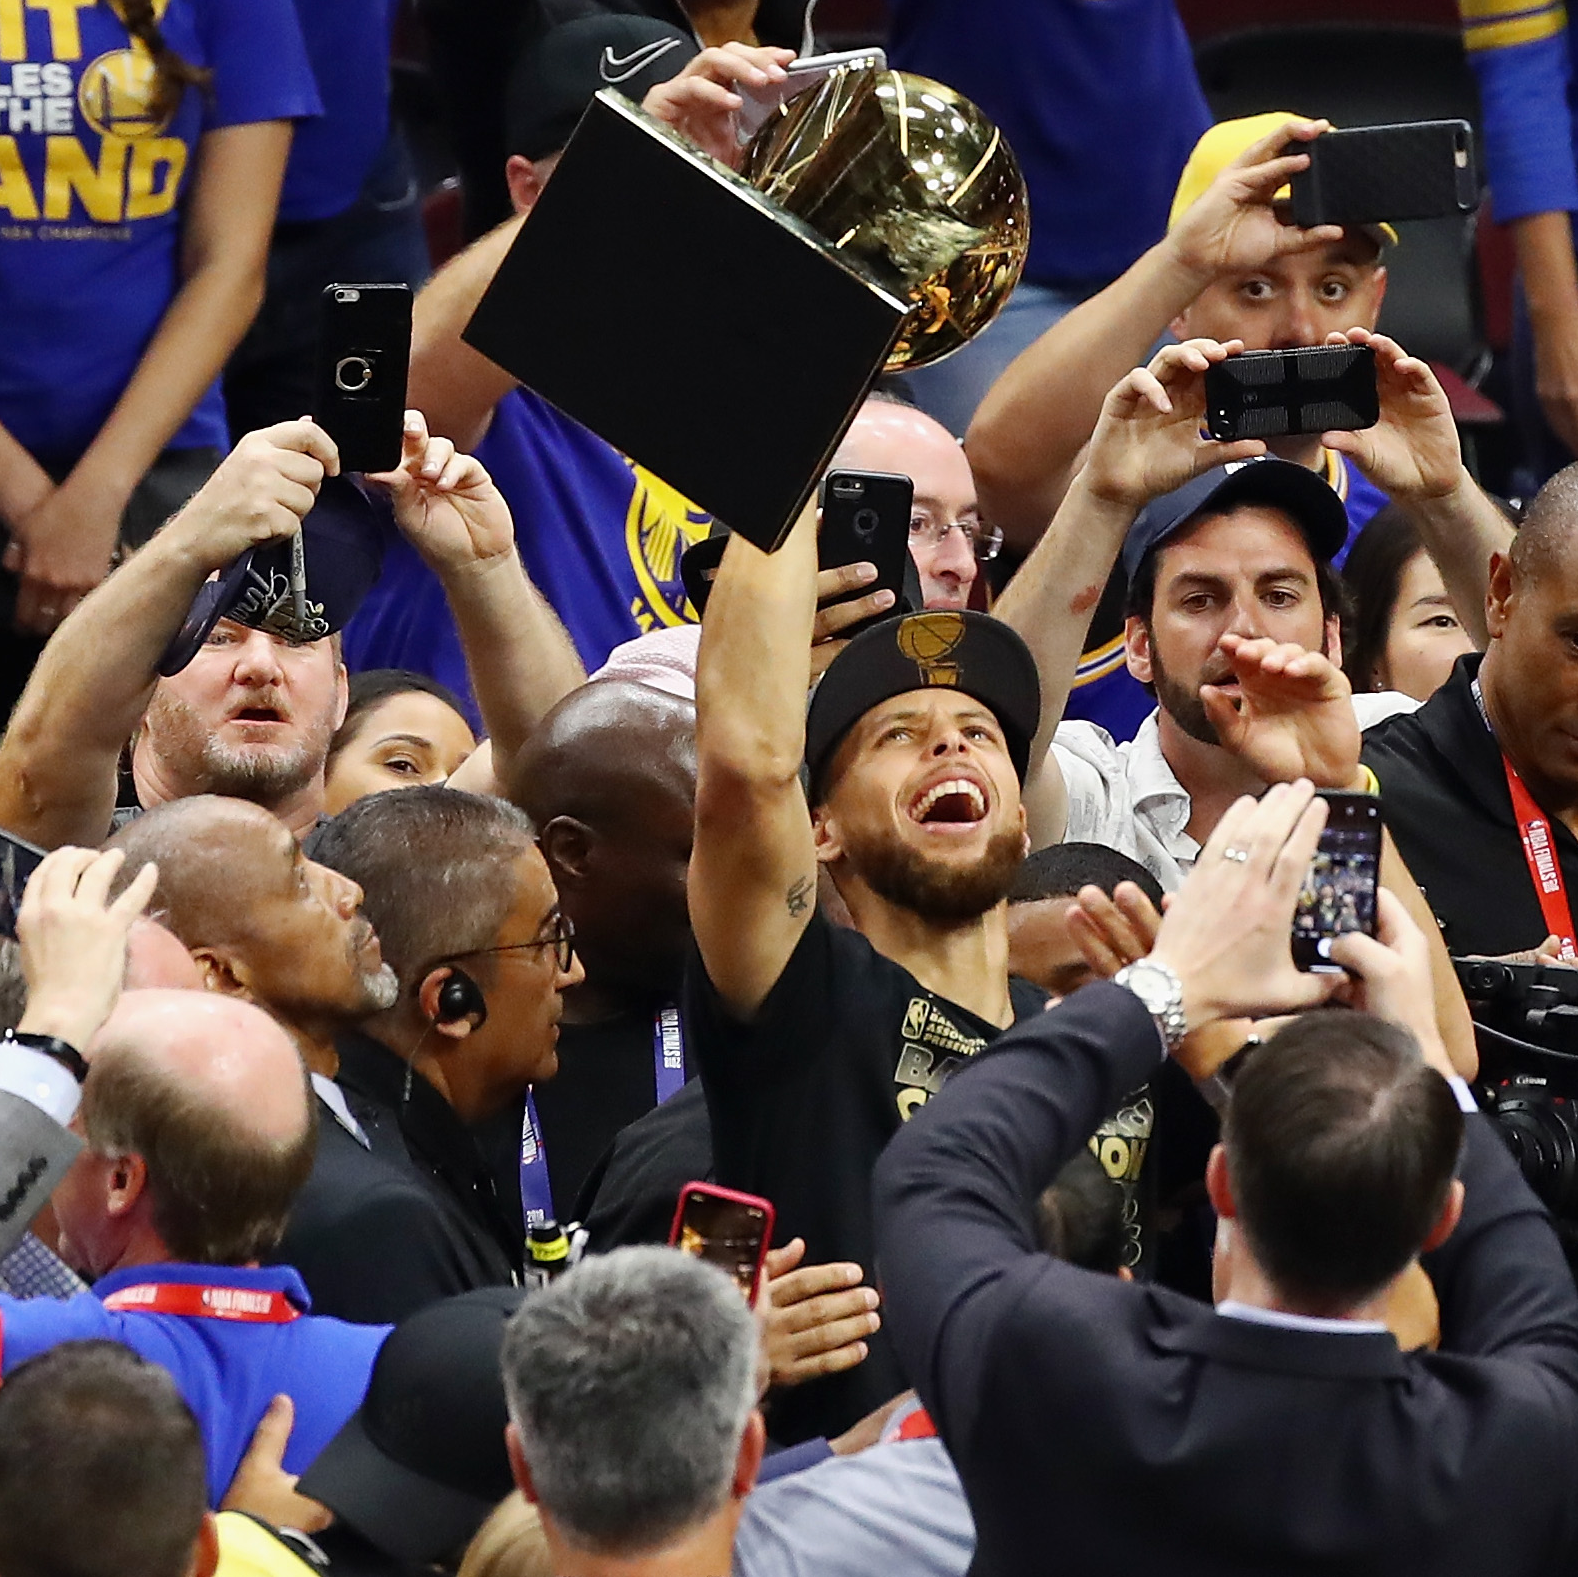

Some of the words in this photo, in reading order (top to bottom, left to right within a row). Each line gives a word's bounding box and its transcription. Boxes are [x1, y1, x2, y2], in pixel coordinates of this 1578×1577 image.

[1528, 828, 1549, 850] NBA
[1533, 848, 1557, 881] FINALS
[662, 1028, 680, 1056] FINALS
[1516, 1076, 1547, 1086] Canon
